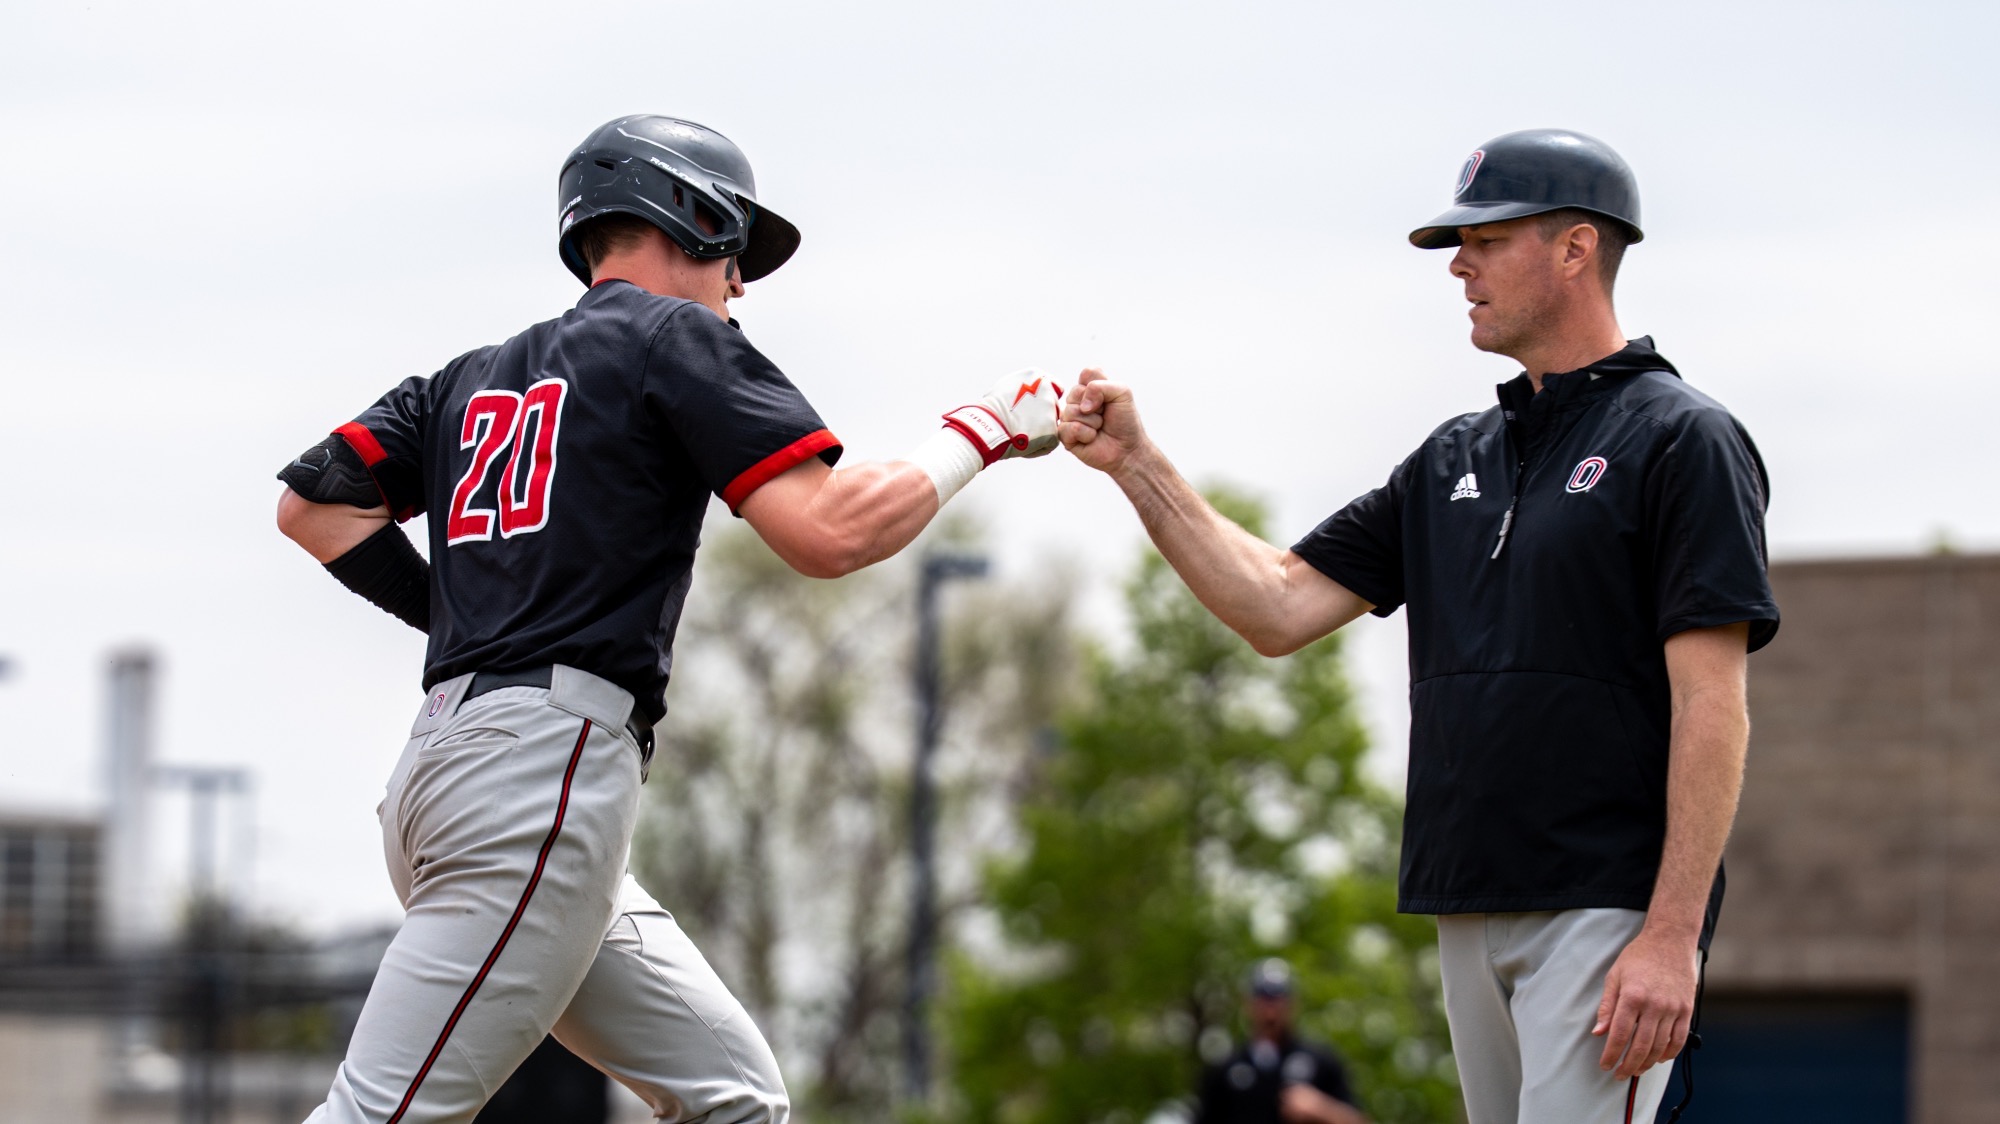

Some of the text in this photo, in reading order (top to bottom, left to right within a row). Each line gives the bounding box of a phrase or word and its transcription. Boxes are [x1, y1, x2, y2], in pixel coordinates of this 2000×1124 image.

[447, 377, 568, 547] 20
[1566, 457, 1607, 492] O
[1450, 489, 1481, 501] adidas
